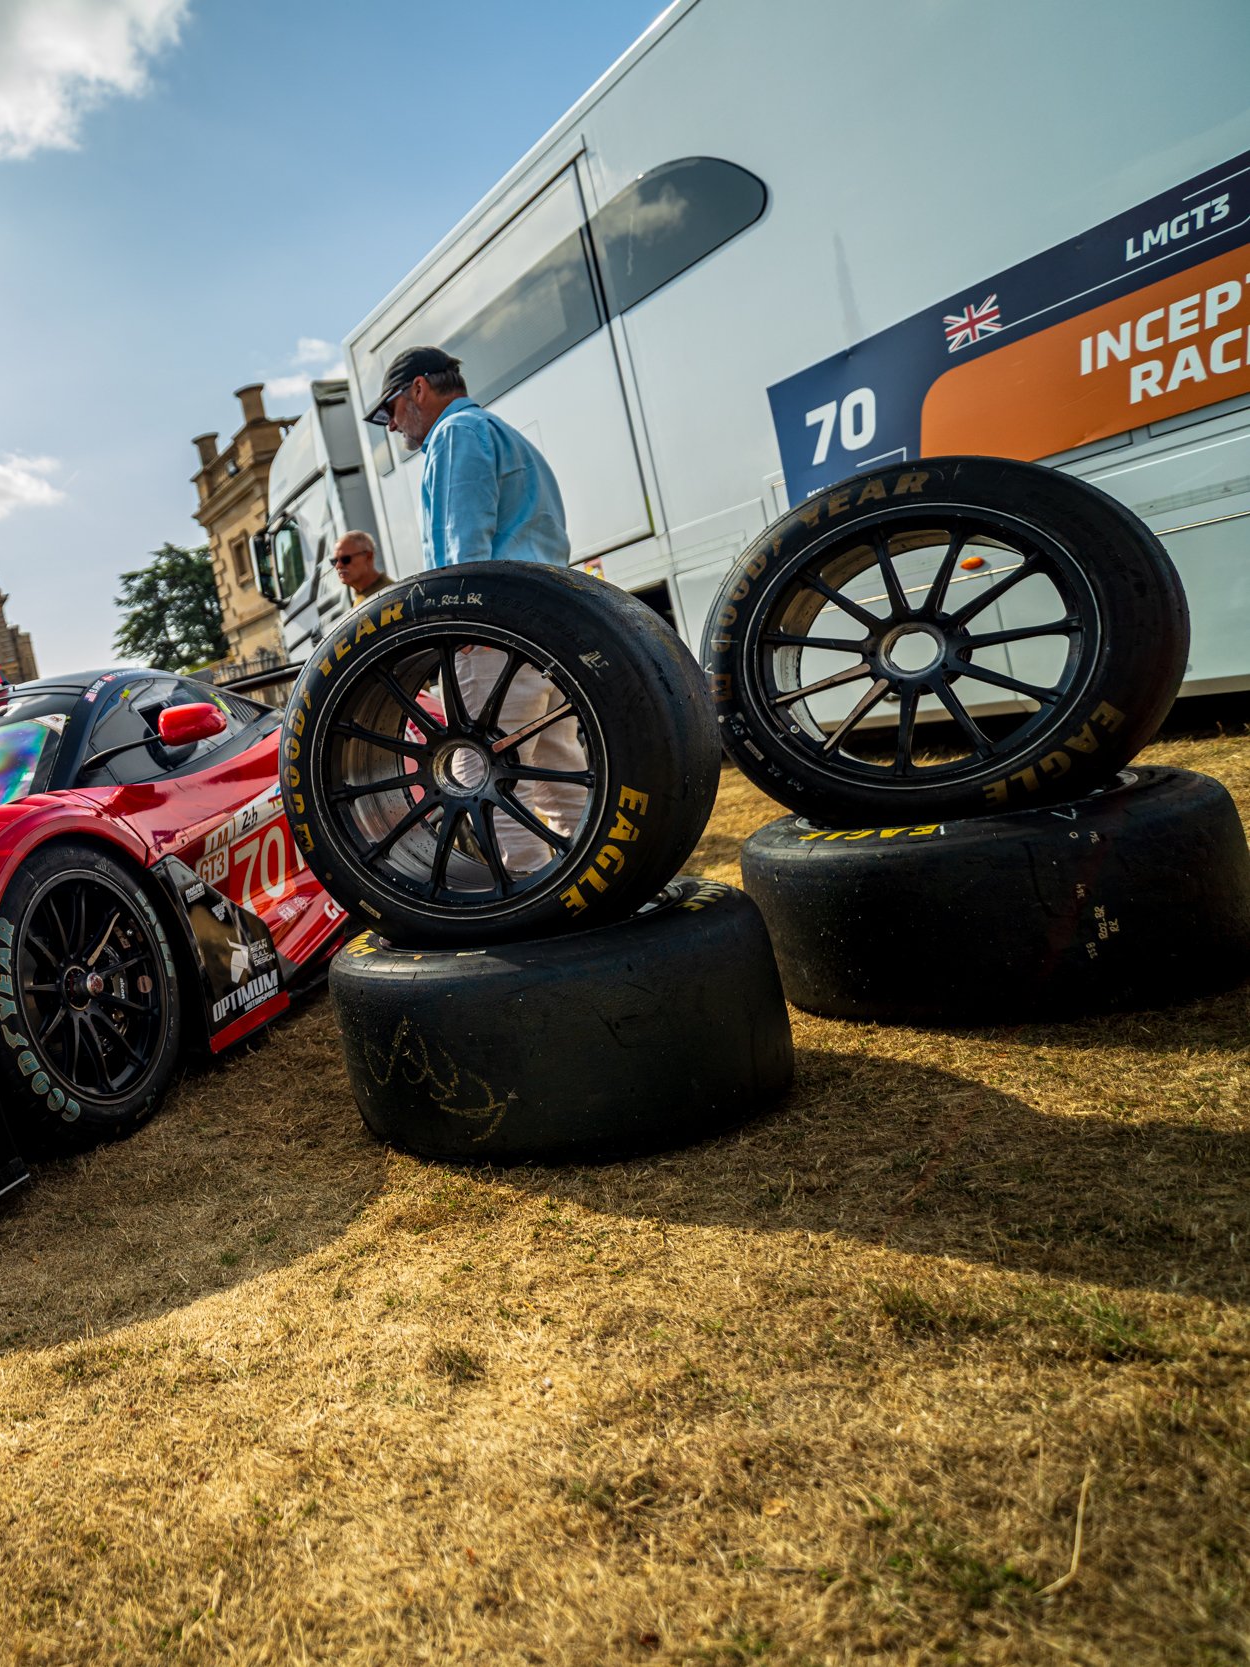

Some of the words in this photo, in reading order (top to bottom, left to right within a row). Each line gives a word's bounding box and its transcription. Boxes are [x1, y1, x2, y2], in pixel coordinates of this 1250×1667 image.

[1125, 193, 1230, 262] LMGT3
[1080, 272, 1250, 376] INCEP
[1130, 326, 1250, 405] RAC
[805, 387, 876, 466] 70
[982, 701, 1127, 807] EAGLE
[234, 825, 286, 917] 70
[559, 785, 649, 917] EAGLE
[213, 968, 279, 1023] OPTIMUM
